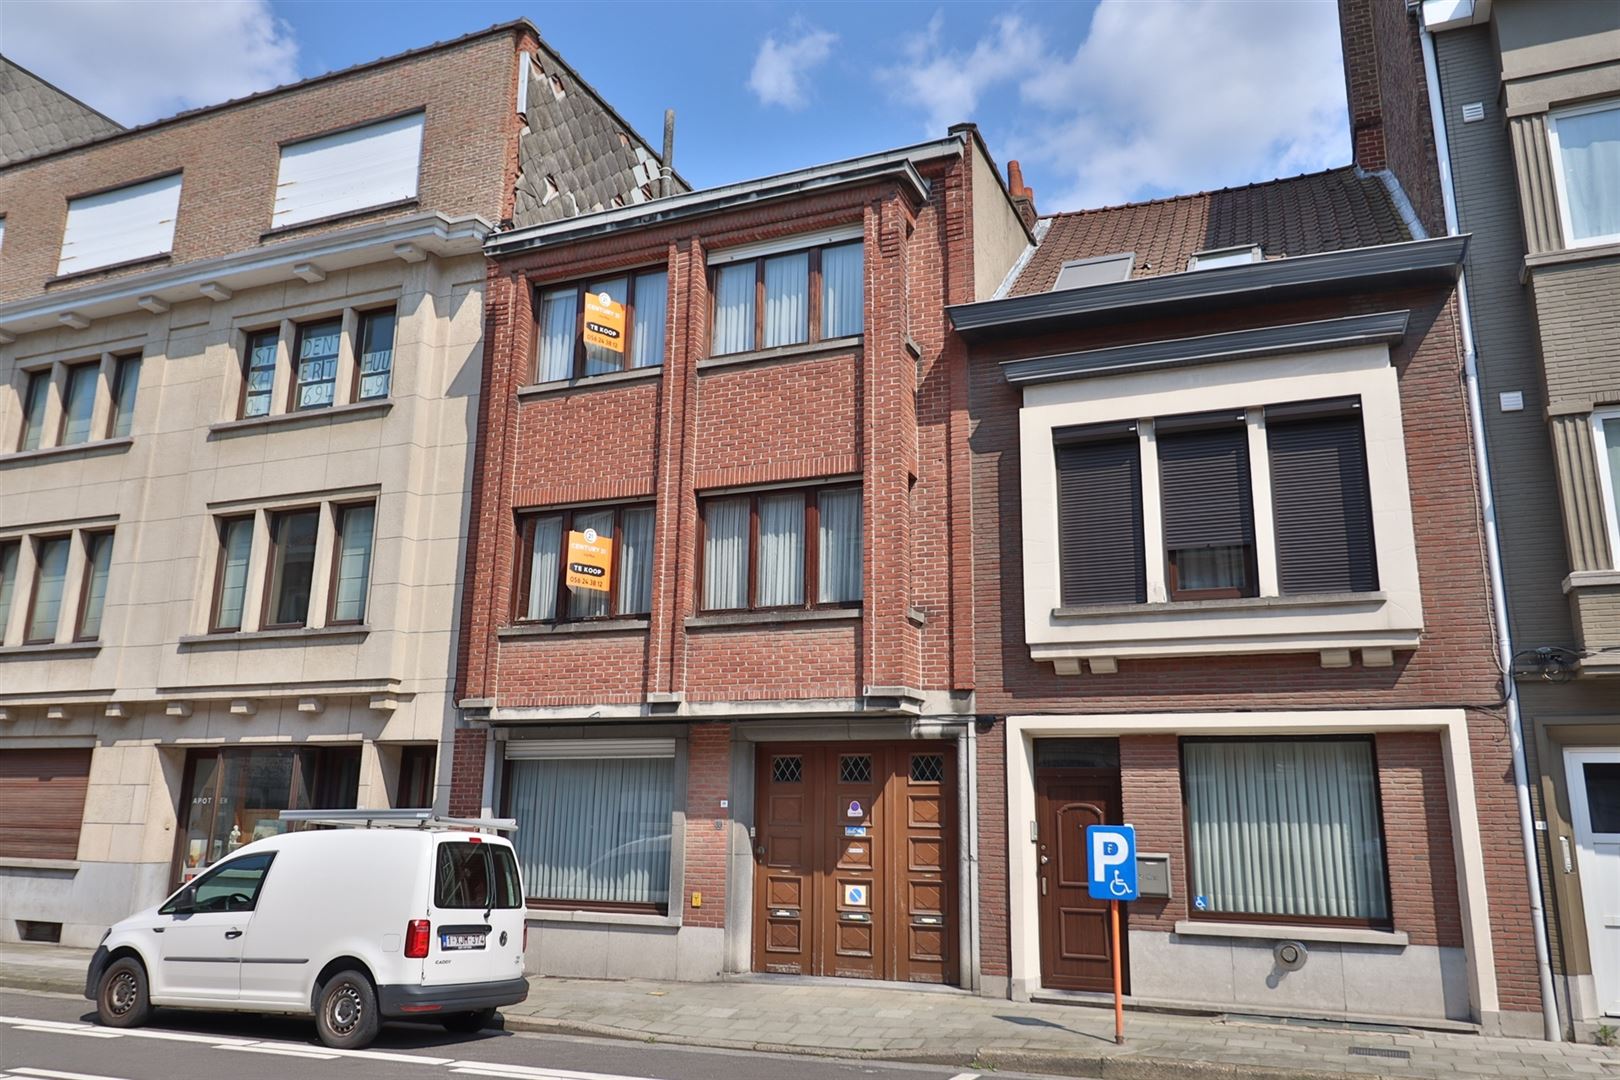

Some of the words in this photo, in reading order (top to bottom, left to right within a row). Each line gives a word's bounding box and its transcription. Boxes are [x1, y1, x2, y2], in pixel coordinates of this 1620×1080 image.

[590, 323, 598, 331] TE
[600, 327, 617, 336] KOOP
[584, 567, 602, 575] KOOP
[1093, 832, 1129, 882] P
